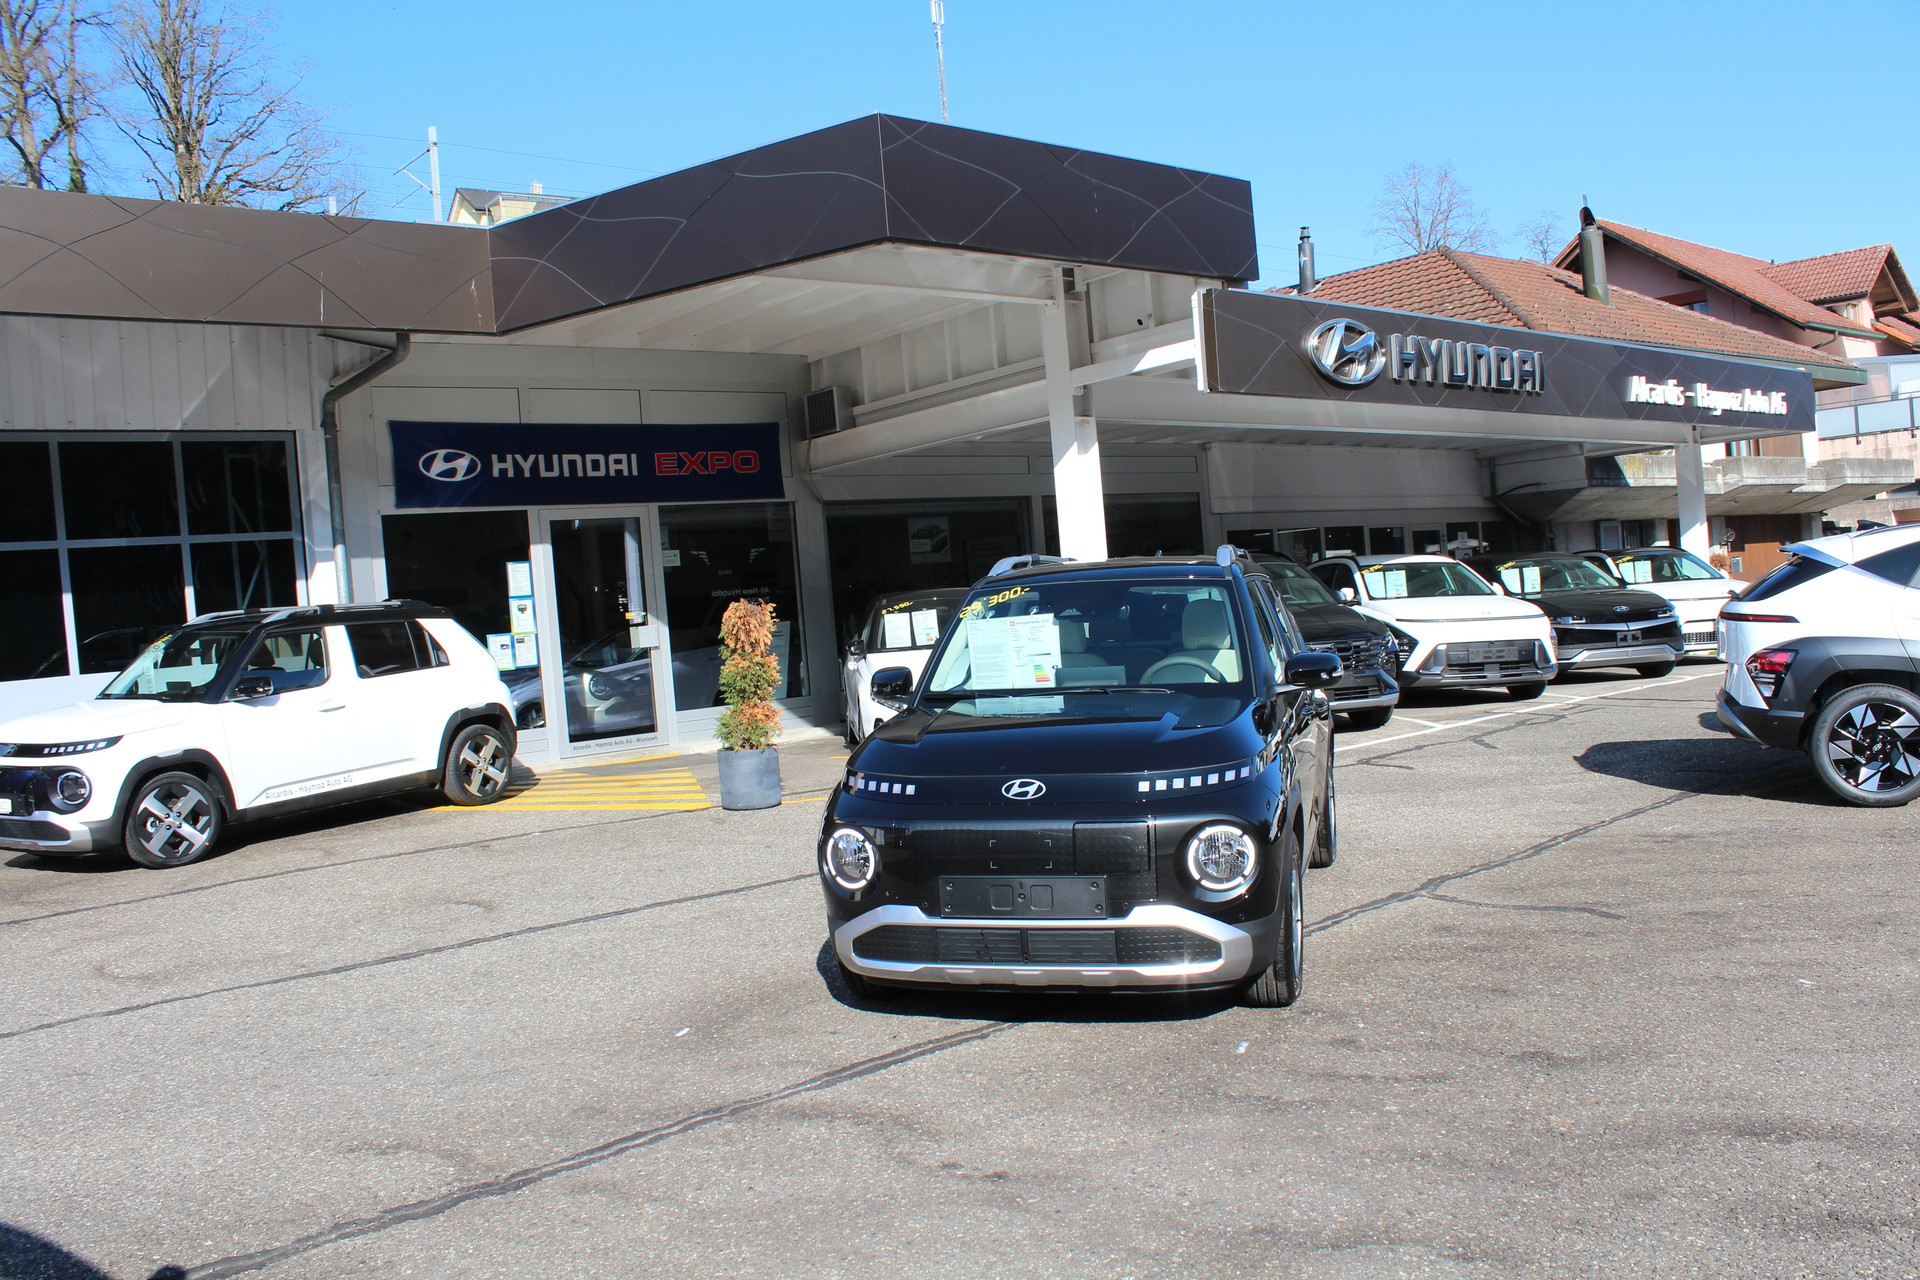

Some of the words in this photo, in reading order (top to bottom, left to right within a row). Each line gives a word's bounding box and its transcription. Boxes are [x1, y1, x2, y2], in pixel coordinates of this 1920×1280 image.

[1389, 333, 1545, 393] HYUNDAI
[491, 453, 638, 477] HYUNDAI
[655, 451, 760, 476] EXPO
